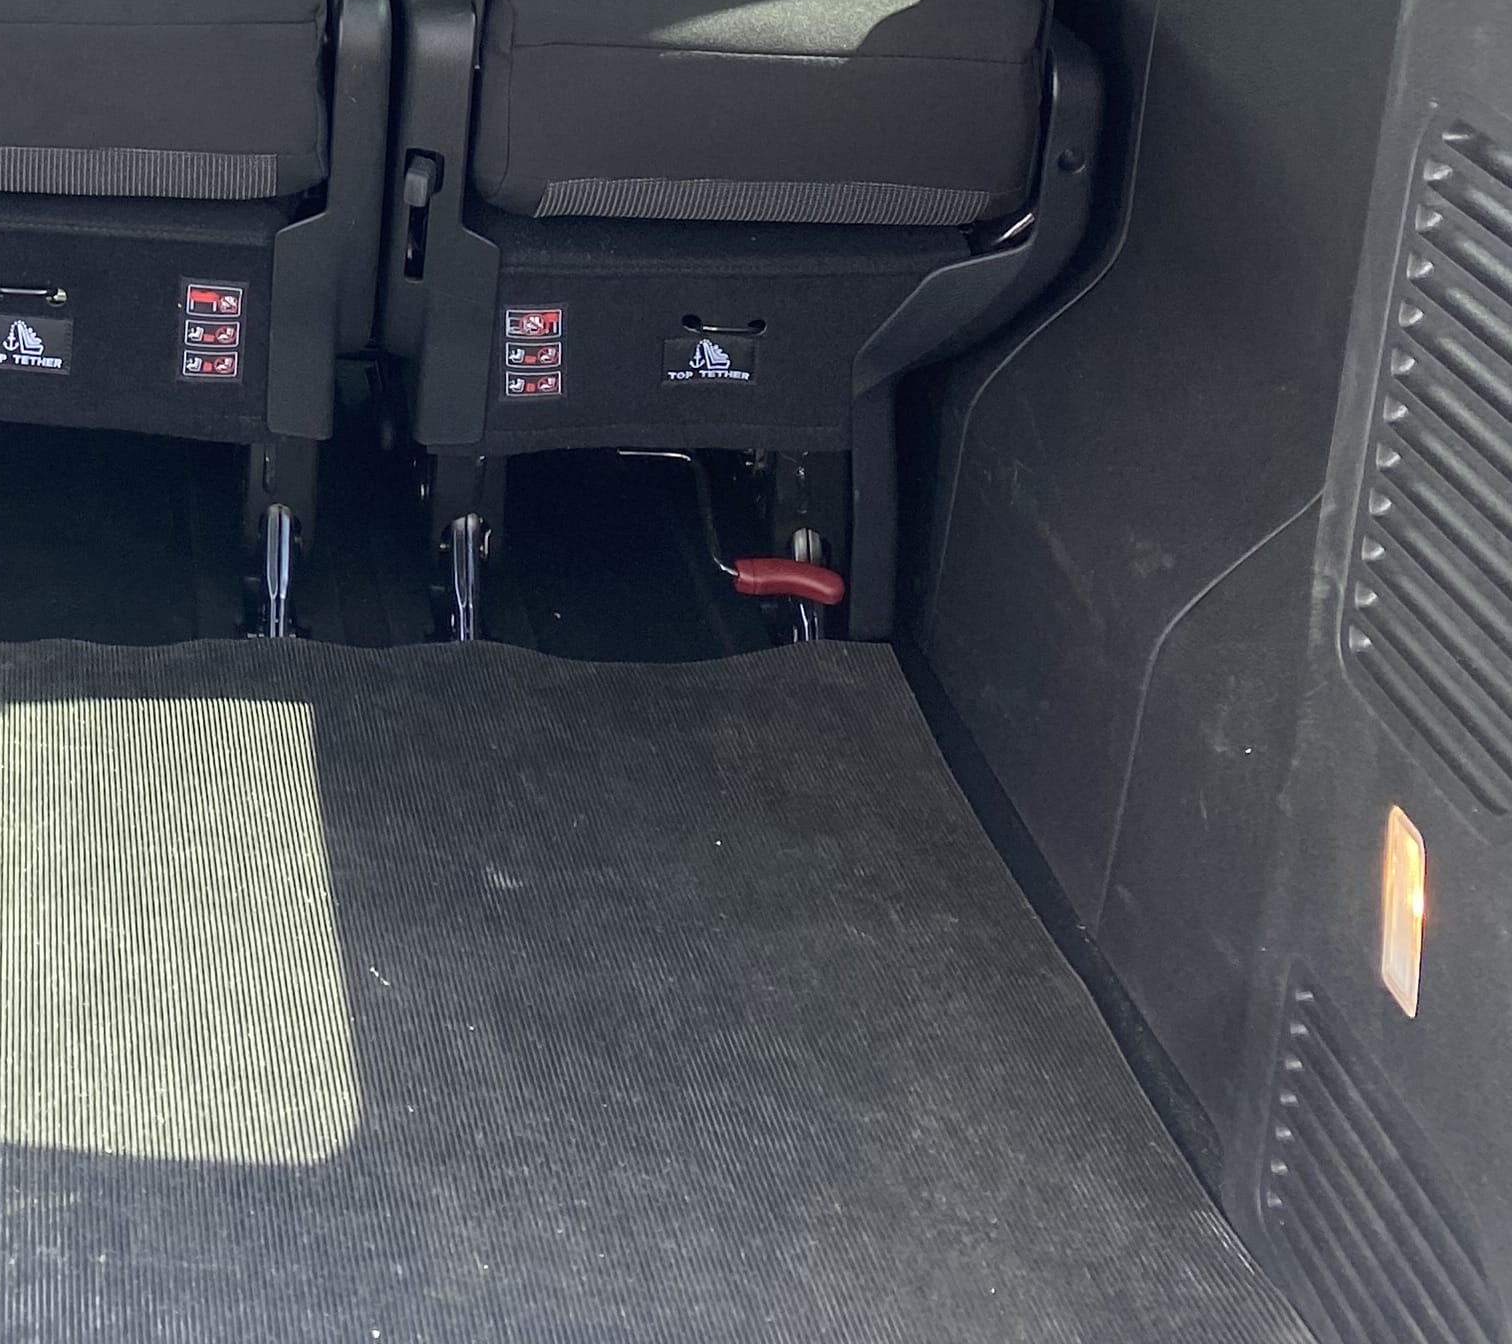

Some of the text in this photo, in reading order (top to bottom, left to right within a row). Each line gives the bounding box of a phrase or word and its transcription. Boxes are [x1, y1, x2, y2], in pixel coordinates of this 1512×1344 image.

[13, 353, 63, 369] TETHER
[668, 369, 751, 381] TOP TETHER
